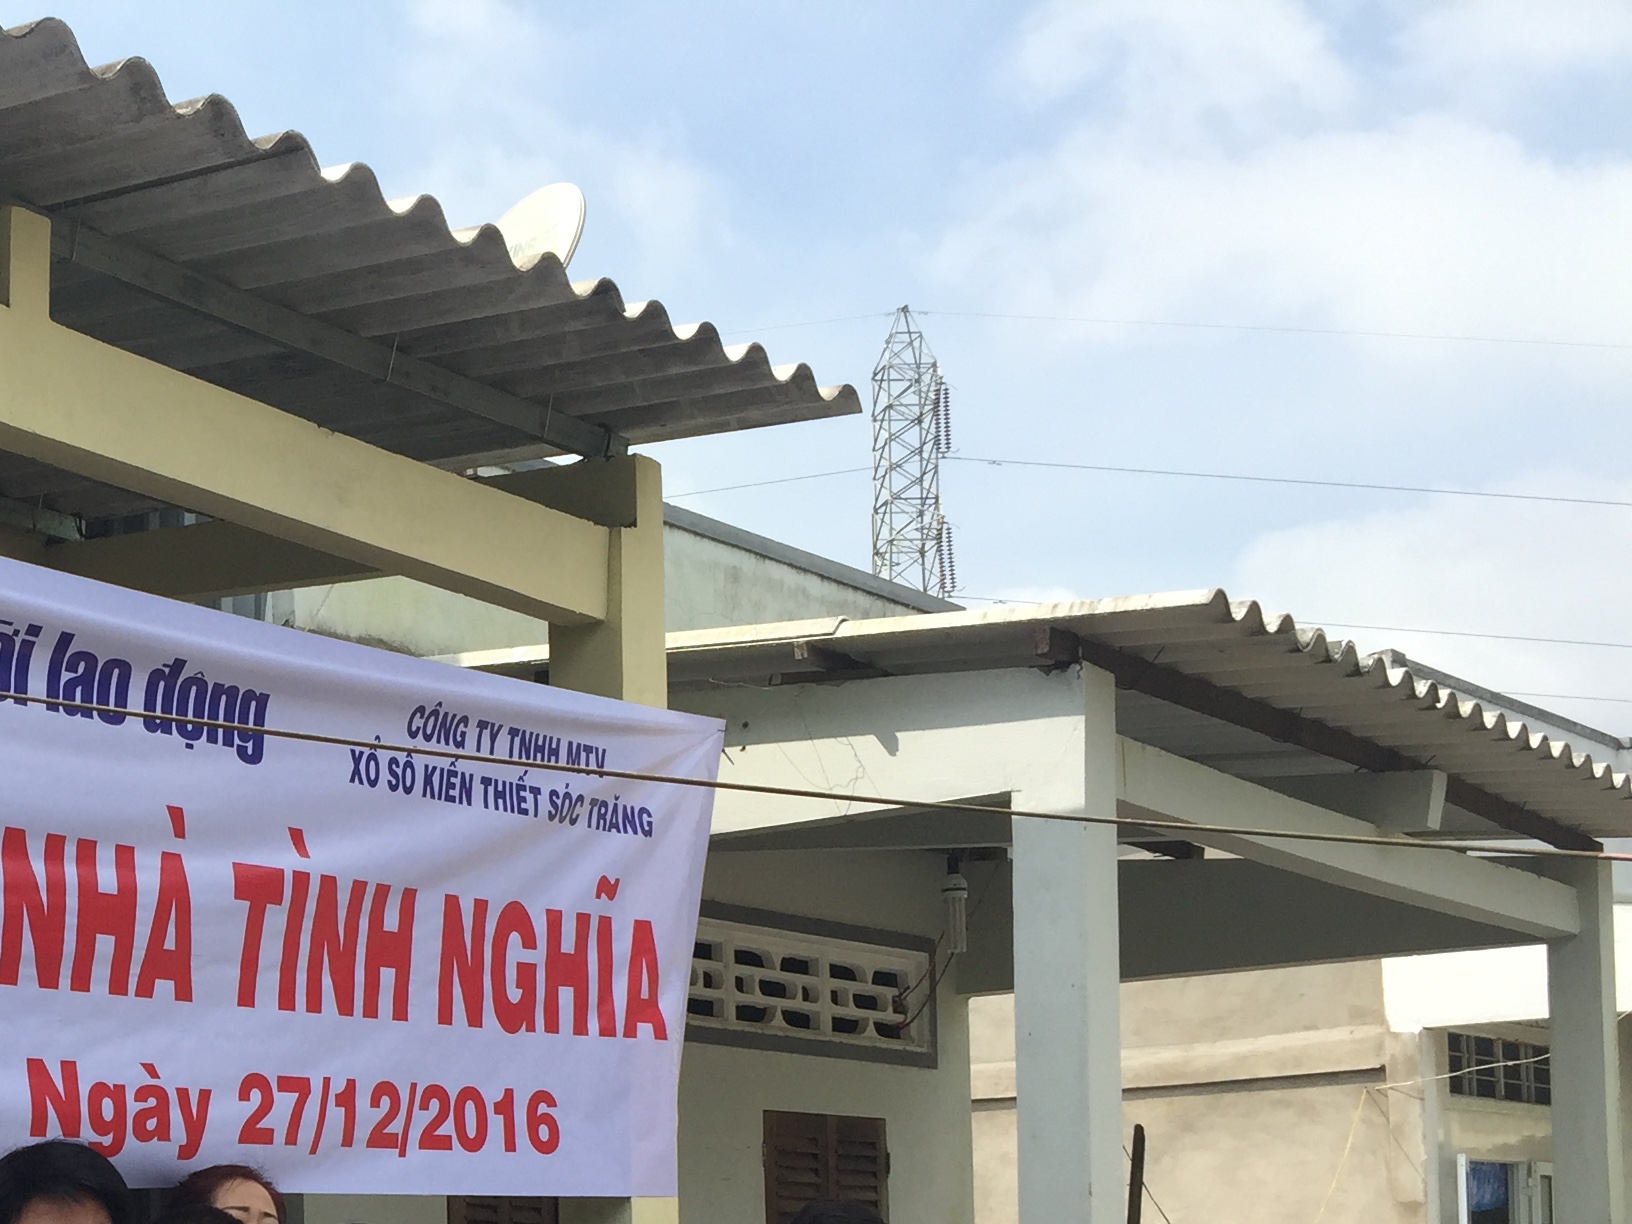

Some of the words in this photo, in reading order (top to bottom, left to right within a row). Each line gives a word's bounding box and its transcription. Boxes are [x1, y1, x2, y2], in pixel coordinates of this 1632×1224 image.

[45, 631, 133, 726] lao
[142, 657, 271, 766] động
[406, 701, 469, 750] CÔNG
[475, 719, 504, 757] TY
[507, 727, 562, 765] TNHH
[566, 740, 607, 778] MTV
[349, 735, 381, 789] XỔ
[421, 756, 474, 807] KIẾN
[480, 770, 542, 819] THIẾT
[548, 782, 585, 827] SÓC
[586, 794, 654, 838] TRĂNG
[232, 826, 418, 1023] TÌNH
[438, 875, 668, 1041] NGHĨA
[26, 1057, 213, 1161] Ngày
[237, 1072, 561, 1159] 27/12/2016
